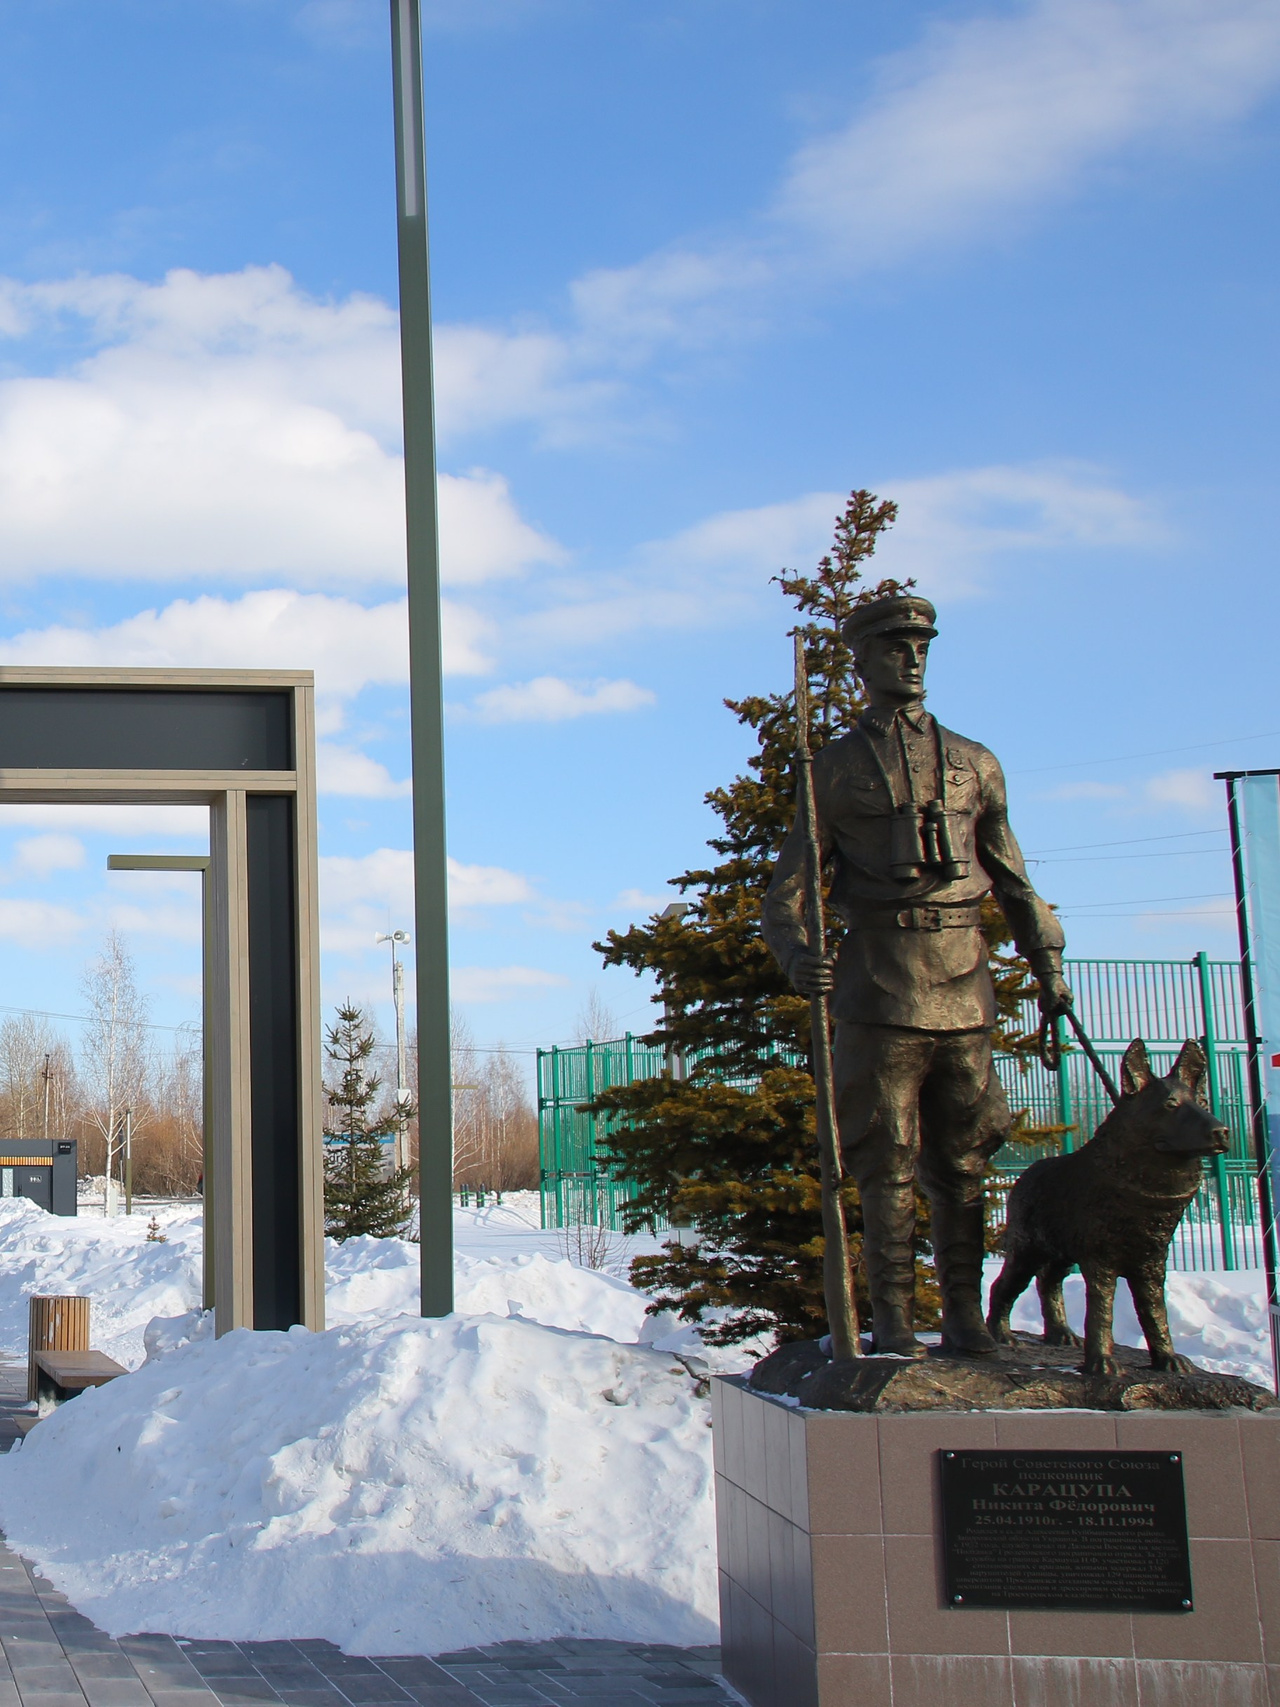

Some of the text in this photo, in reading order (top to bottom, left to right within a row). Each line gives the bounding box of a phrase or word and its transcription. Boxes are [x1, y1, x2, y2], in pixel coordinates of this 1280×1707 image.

[962, 1457, 1160, 1471] Герой Советского Союза
[1019, 1472, 1103, 1481] полковник
[993, 1482, 1132, 1500] КАРАЦУПА
[973, 1499, 1154, 1515] Никита Фёдорович
[975, 1515, 1062, 1526] 25.04.1910г.
[1079, 1517, 1154, 1527] 18.11.1994
